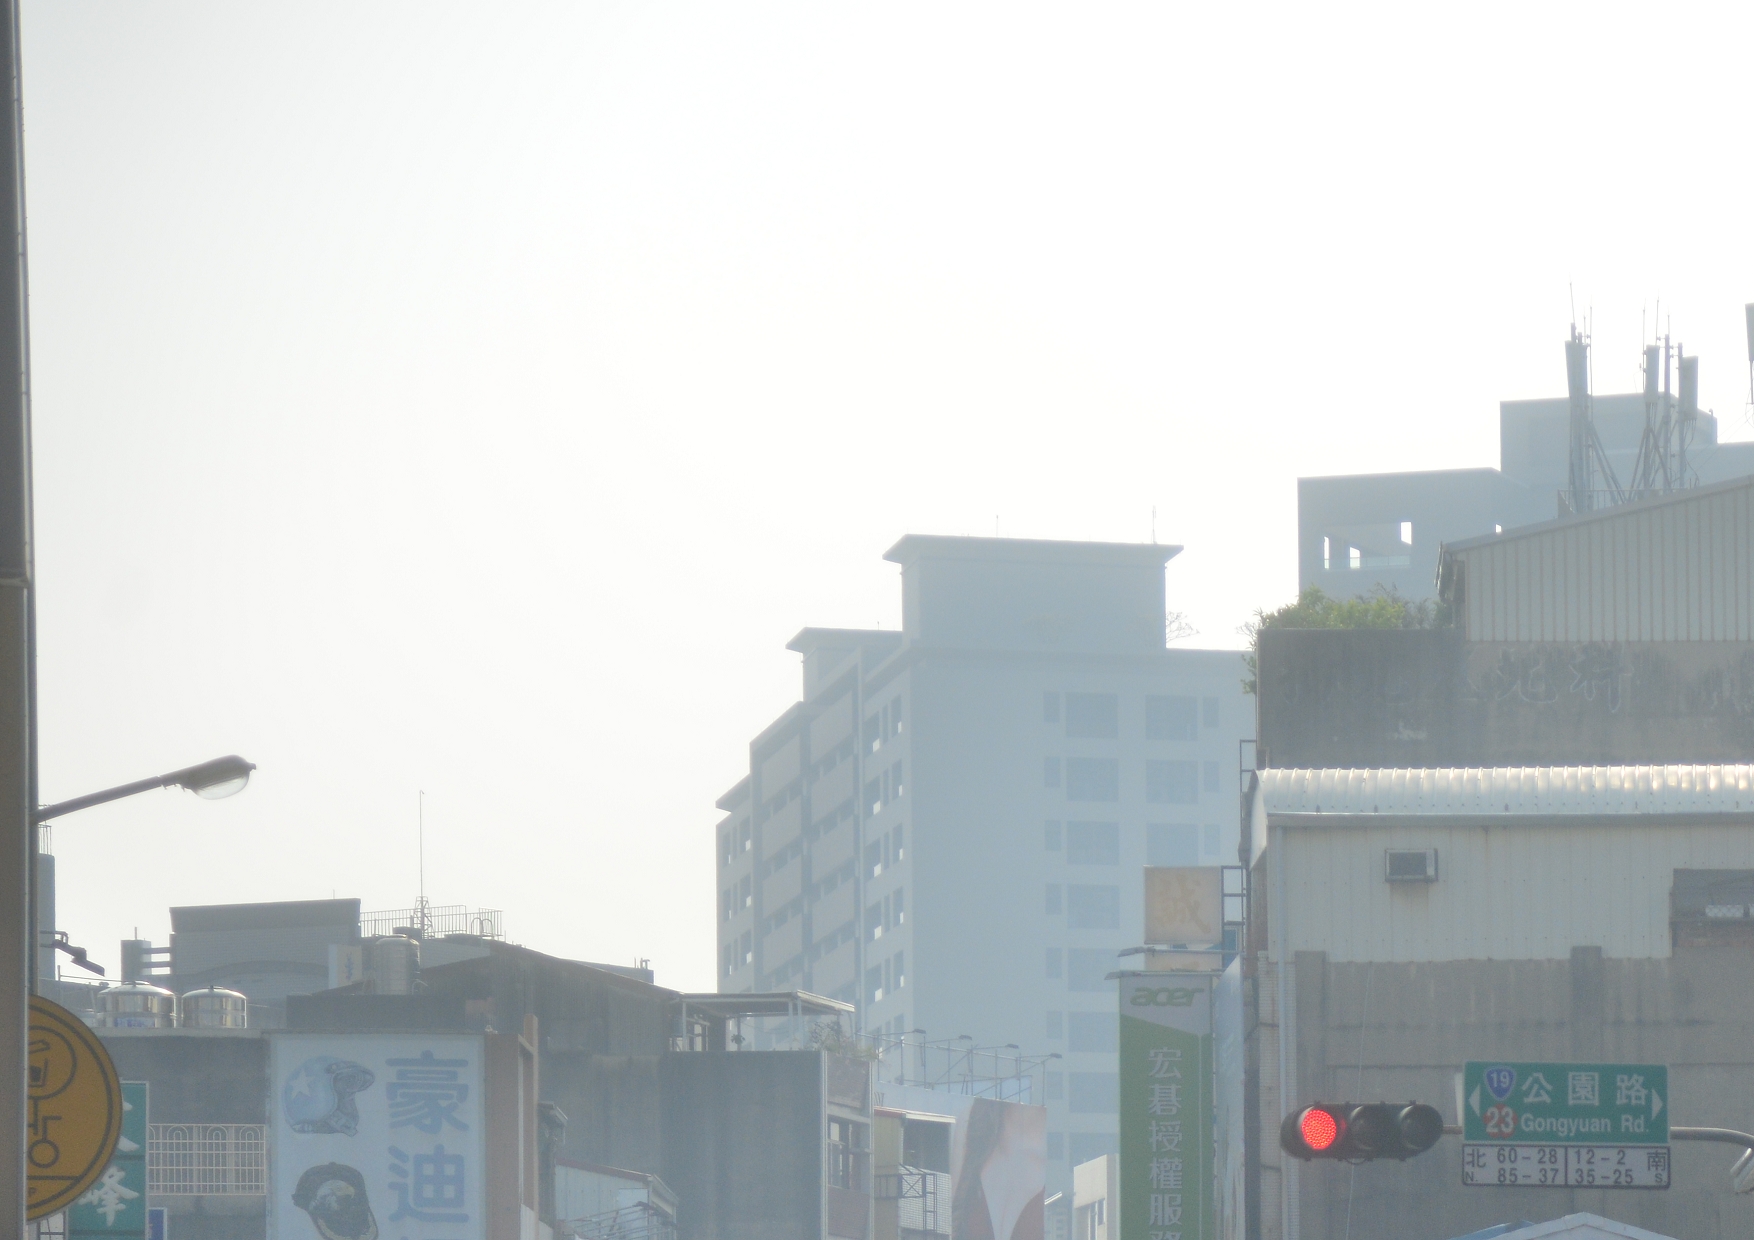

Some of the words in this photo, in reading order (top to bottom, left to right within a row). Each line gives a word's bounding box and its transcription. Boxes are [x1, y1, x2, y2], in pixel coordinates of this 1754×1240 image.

[1130, 987, 1204, 1007] acer
[1490, 1071, 1509, 1088] 19
[1522, 1071, 1648, 1106] 公園路
[1486, 1107, 1514, 1133] 23
[1521, 1113, 1611, 1136] Gongyuan
[1621, 1115, 1649, 1132] Rd.
[1466, 1150, 1486, 1168] 北
[1647, 1151, 1667, 1171] 南
